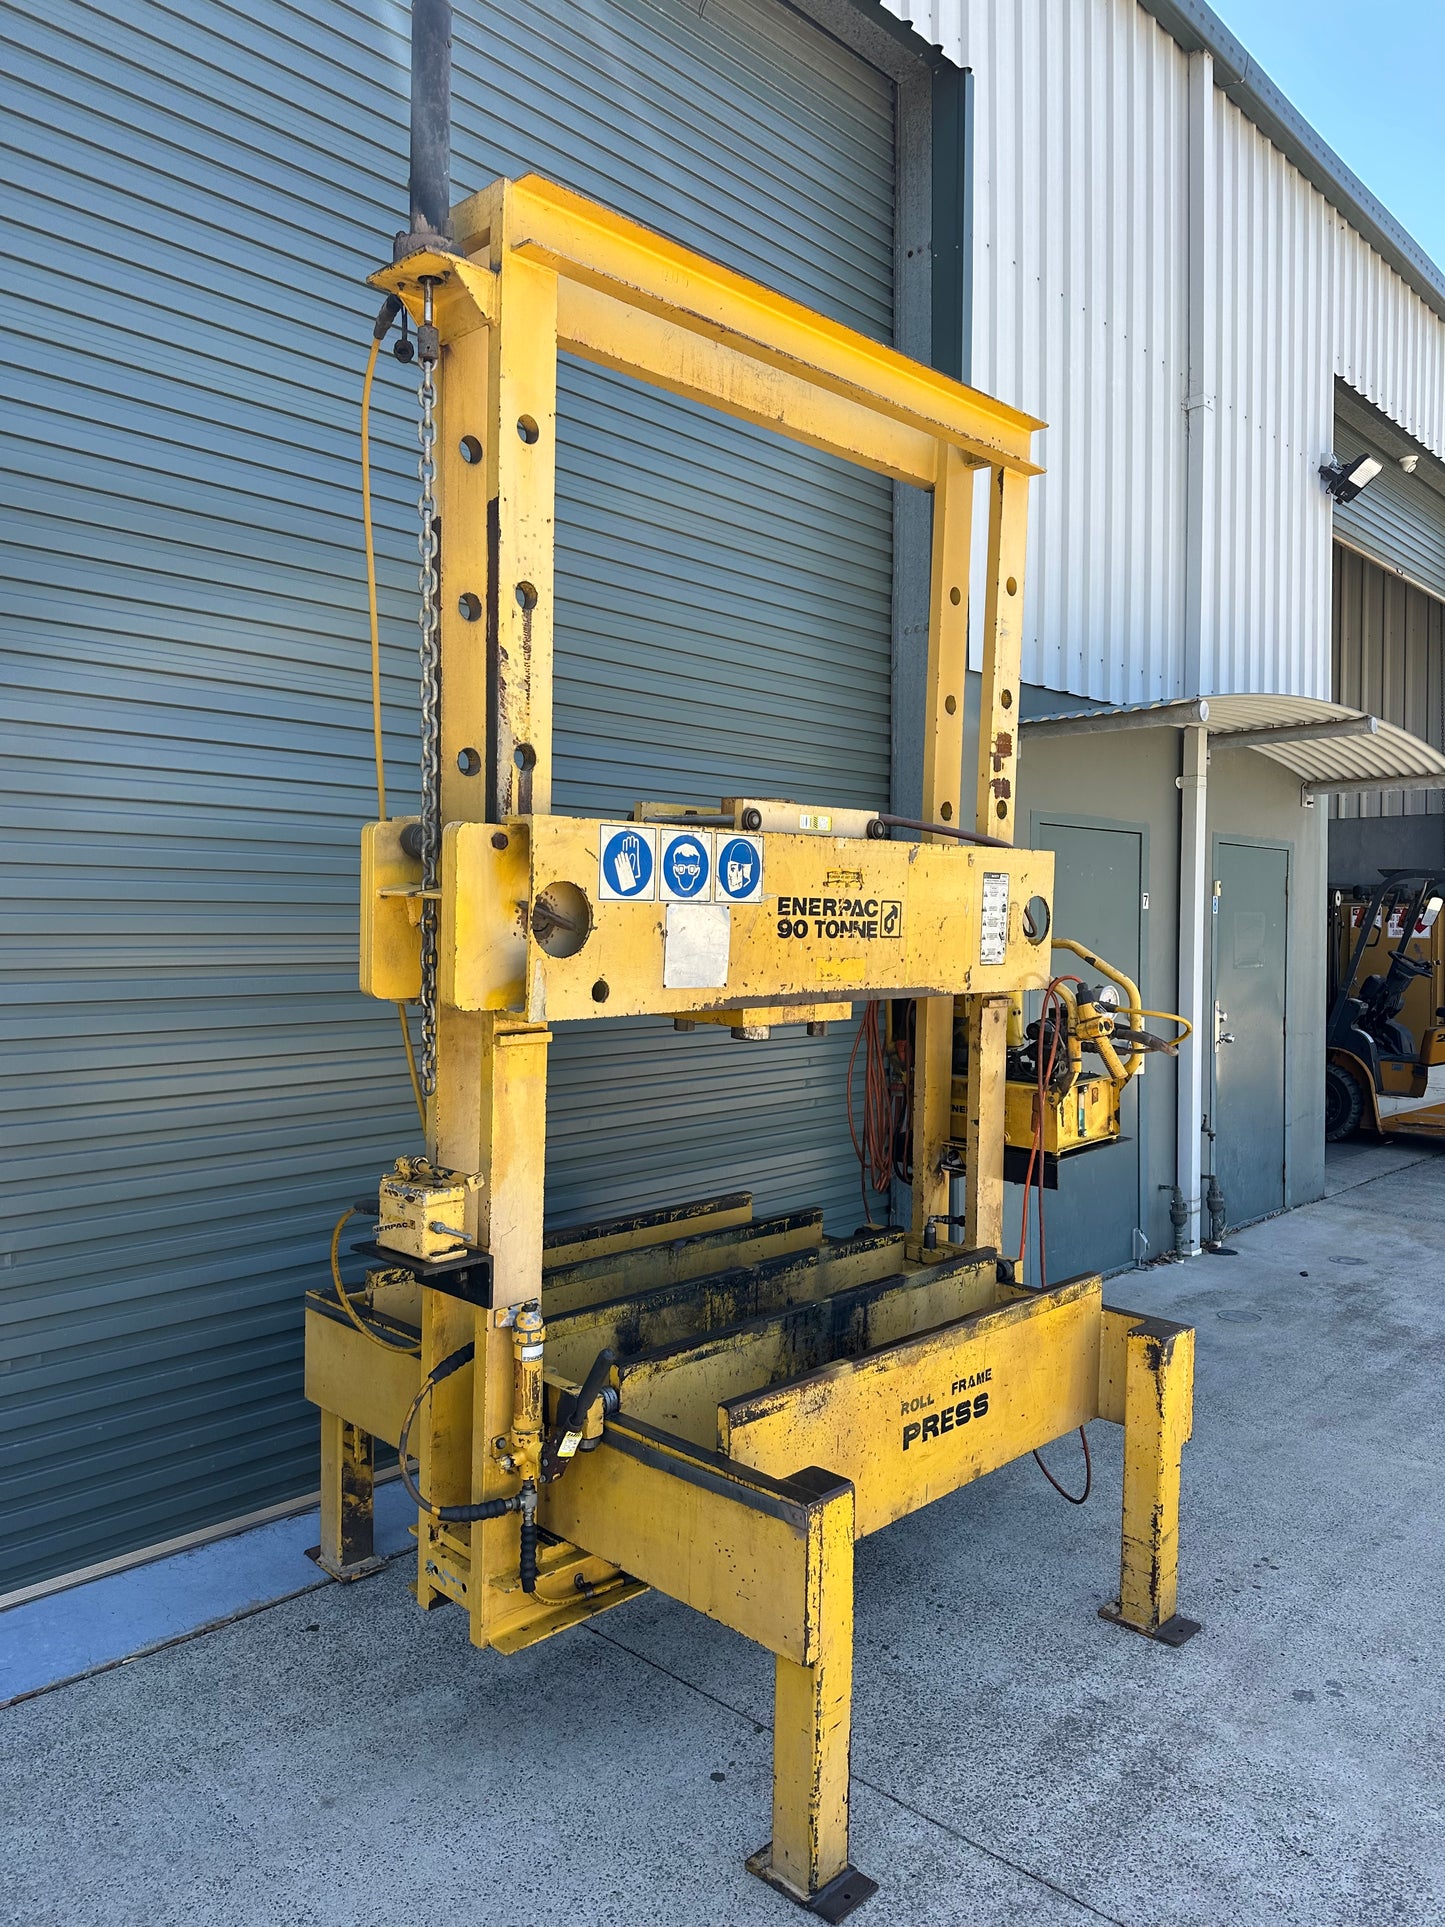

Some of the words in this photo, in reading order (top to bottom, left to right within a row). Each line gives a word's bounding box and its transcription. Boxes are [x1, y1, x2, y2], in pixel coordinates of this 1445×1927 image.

[777, 896, 879, 918] ENERPAC
[1143, 895, 1148, 906] 7
[777, 919, 809, 939] 90
[814, 919, 879, 939] TONNE
[901, 1393, 934, 1416] ROLL
[951, 1367, 993, 1396] FRAME
[902, 1392, 989, 1451] PRESS
